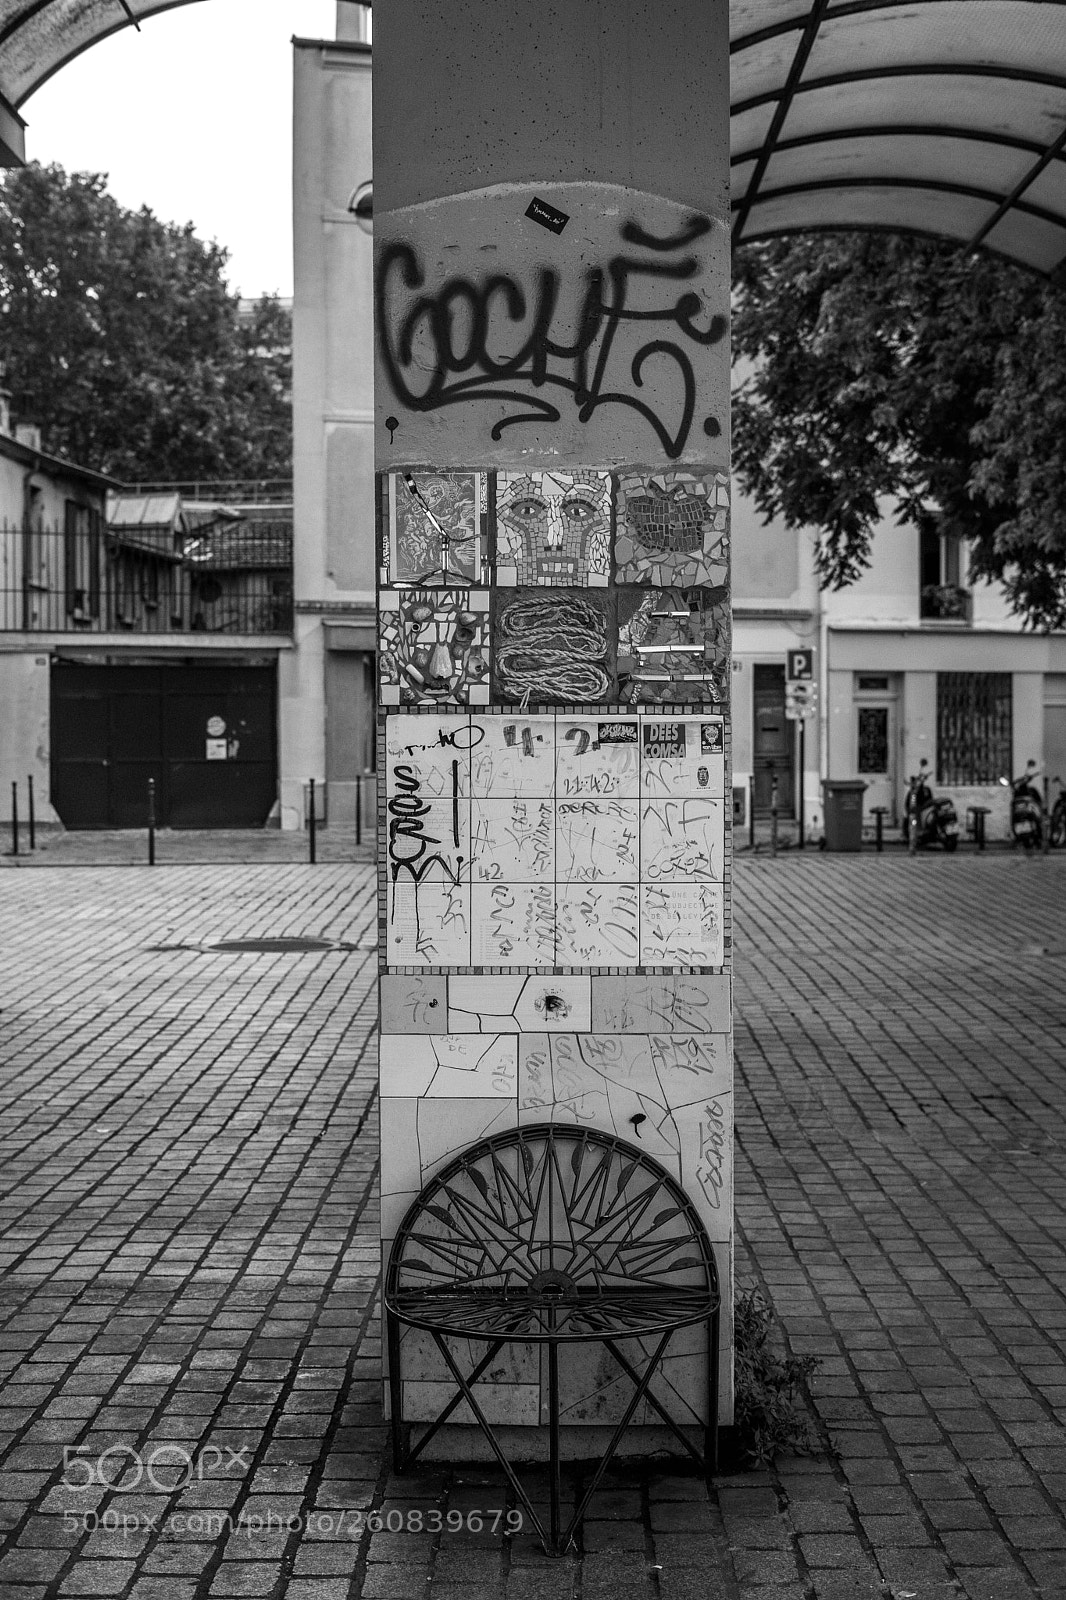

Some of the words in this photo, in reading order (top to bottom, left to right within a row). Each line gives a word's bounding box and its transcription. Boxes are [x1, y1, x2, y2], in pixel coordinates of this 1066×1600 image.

[793, 654, 807, 677] P
[650, 723, 679, 741] DEES
[644, 743, 686, 759] COMSA
